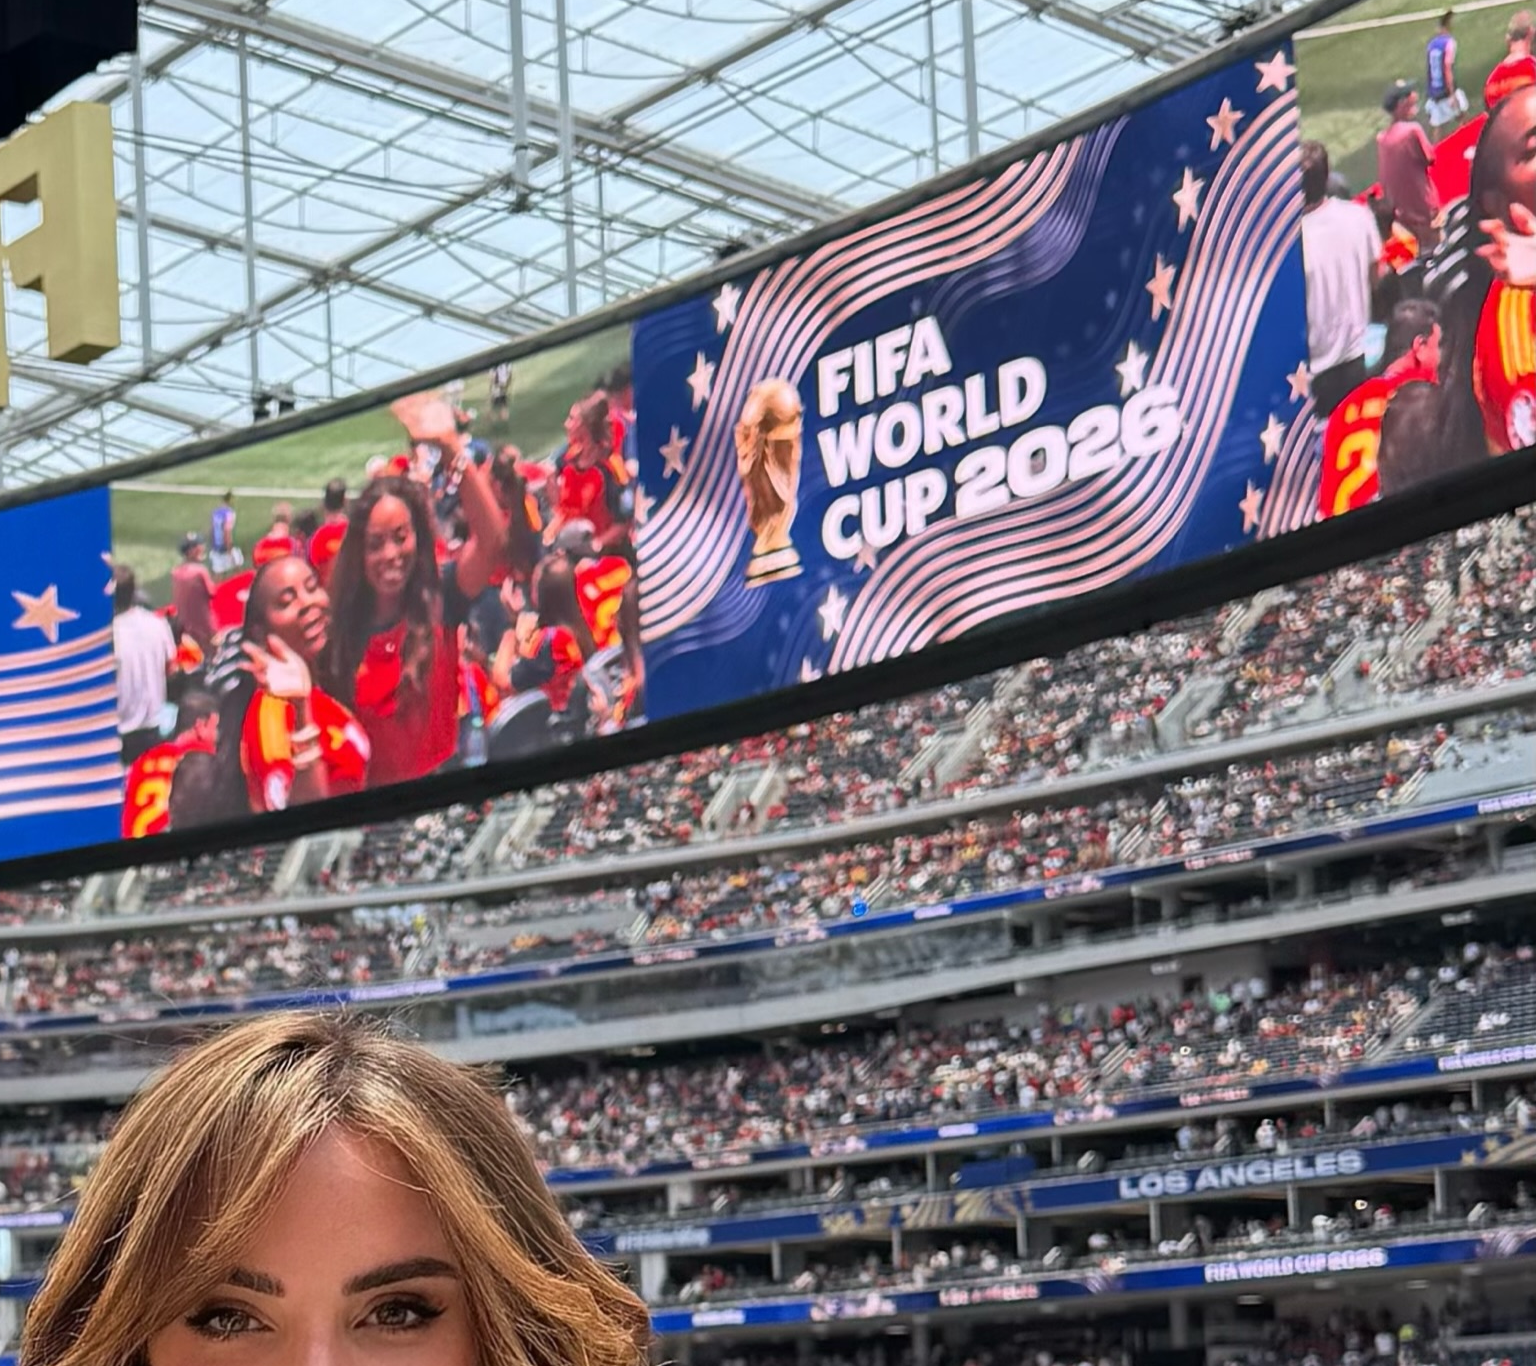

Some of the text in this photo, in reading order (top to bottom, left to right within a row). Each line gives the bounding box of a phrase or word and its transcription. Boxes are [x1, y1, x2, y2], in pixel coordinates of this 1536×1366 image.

[817, 315, 951, 418] FIFA
[817, 357, 1046, 488] WORLD
[821, 383, 1181, 560] CUP 2026
[1119, 1149, 1365, 1199] LOS ANGELES
[1205, 1262, 1239, 1283] FIFA
[1238, 1256, 1294, 1279] WORLD
[1295, 1252, 1327, 1274] CUP
